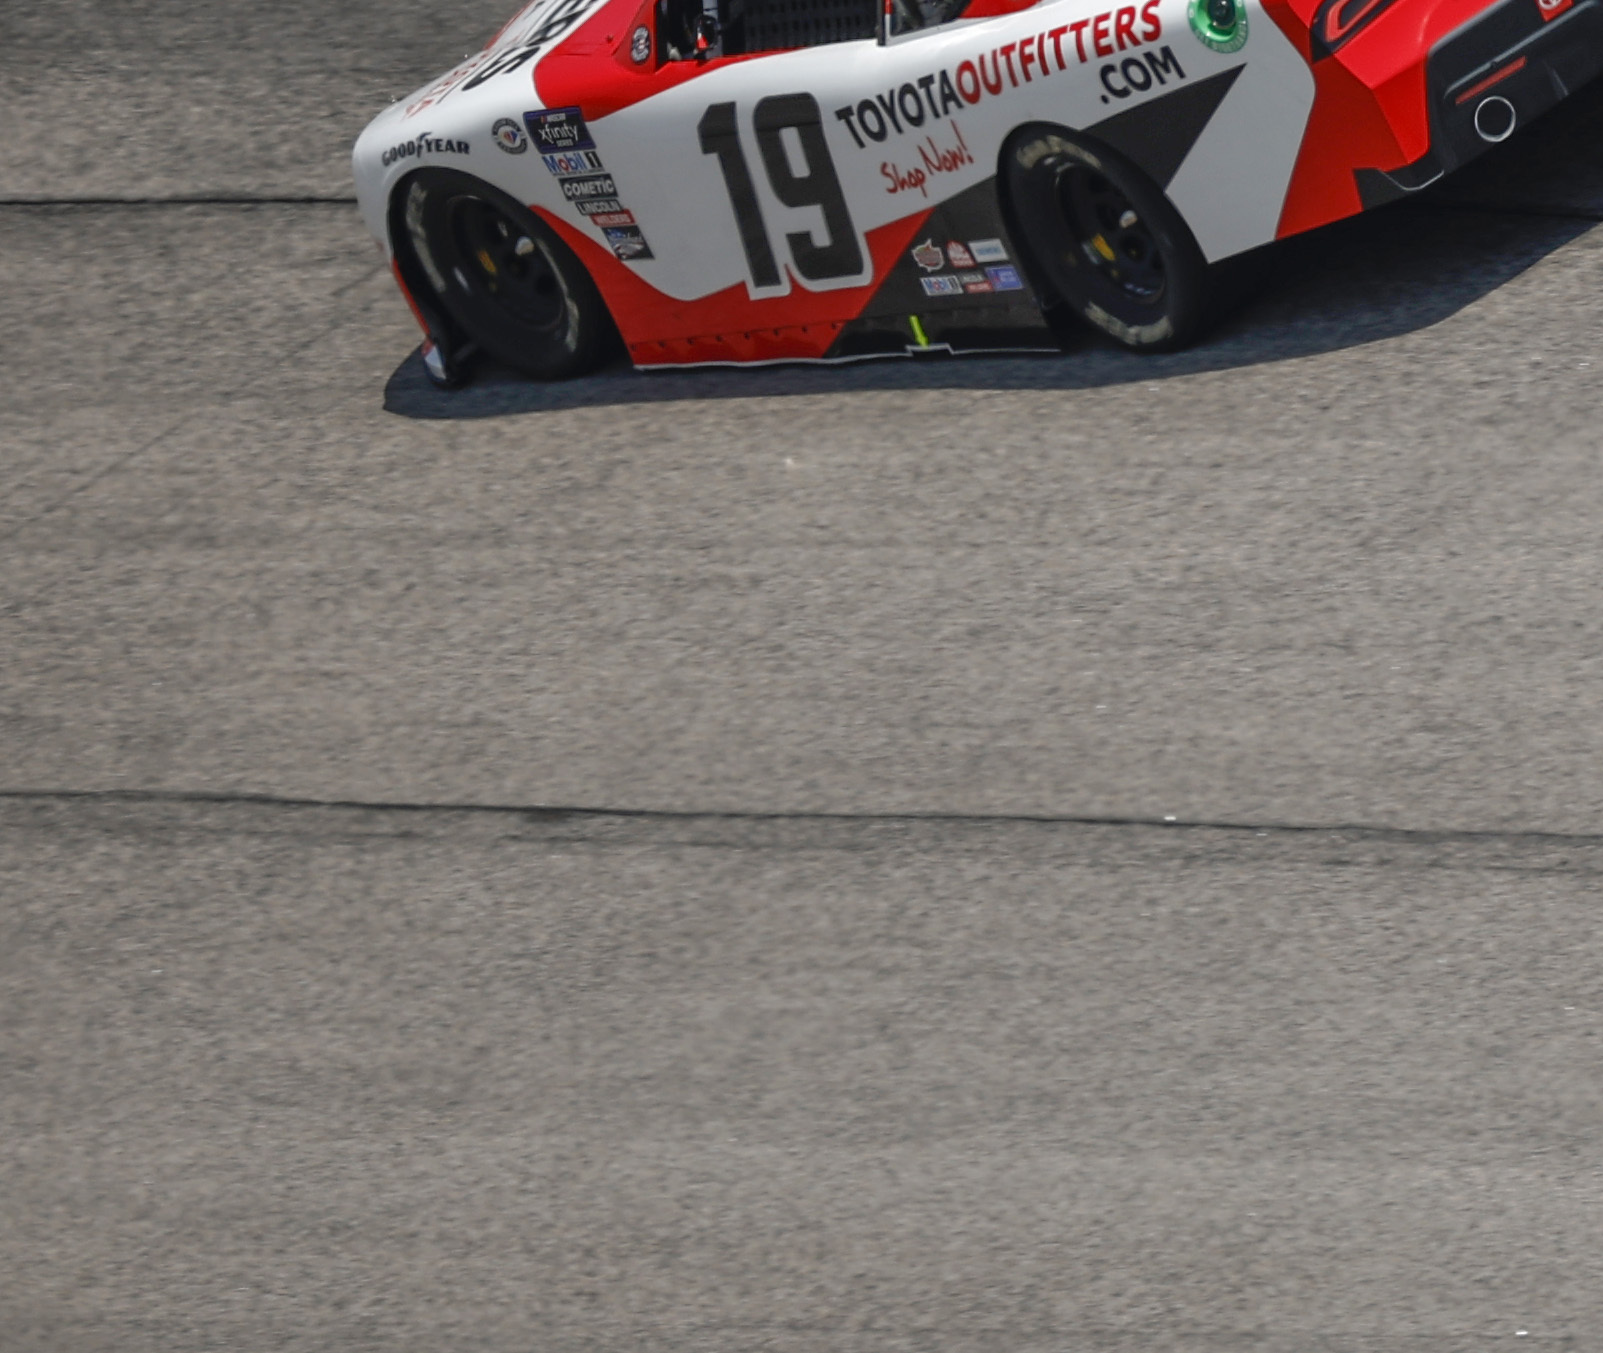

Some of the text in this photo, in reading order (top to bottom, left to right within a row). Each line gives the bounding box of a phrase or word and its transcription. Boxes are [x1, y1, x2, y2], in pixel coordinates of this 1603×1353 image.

[1100, 47, 1186, 104] .COM
[538, 124, 578, 144] xfinity
[382, 132, 470, 167] GOODYEAR
[543, 152, 587, 173] Mobil
[589, 152, 600, 168] 1
[880, 161, 927, 198] Shop
[919, 120, 975, 178] Now!
[564, 180, 615, 197] COMETIC
[697, 92, 867, 288] 19
[578, 200, 621, 214] LINCOLN
